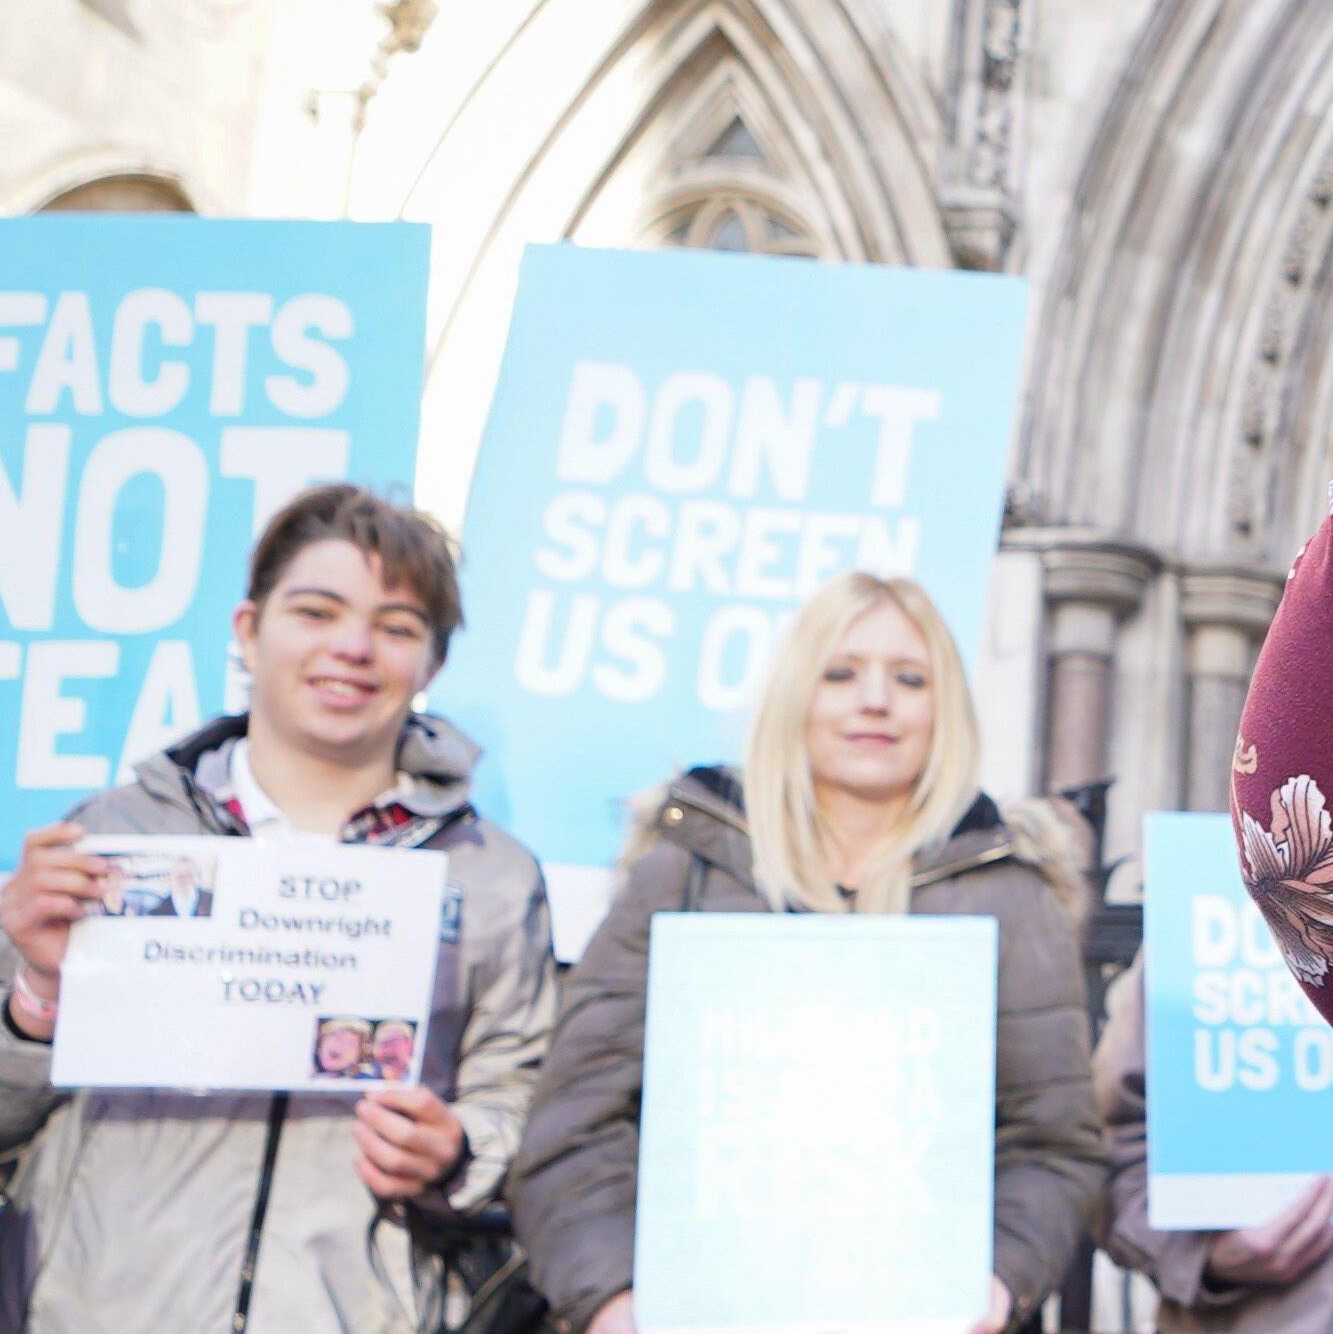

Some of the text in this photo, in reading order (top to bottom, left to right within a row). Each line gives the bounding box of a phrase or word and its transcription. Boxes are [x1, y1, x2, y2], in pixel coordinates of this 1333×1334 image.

[555, 361, 943, 508] DON'T
[514, 589, 676, 705] US
[279, 875, 363, 901] STOP
[239, 909, 392, 939] Downright
[144, 941, 357, 970] Discrimination
[222, 978, 326, 1005] TODAY
[1194, 970, 1330, 1027] SCR
[1194, 1028, 1280, 1092] US
